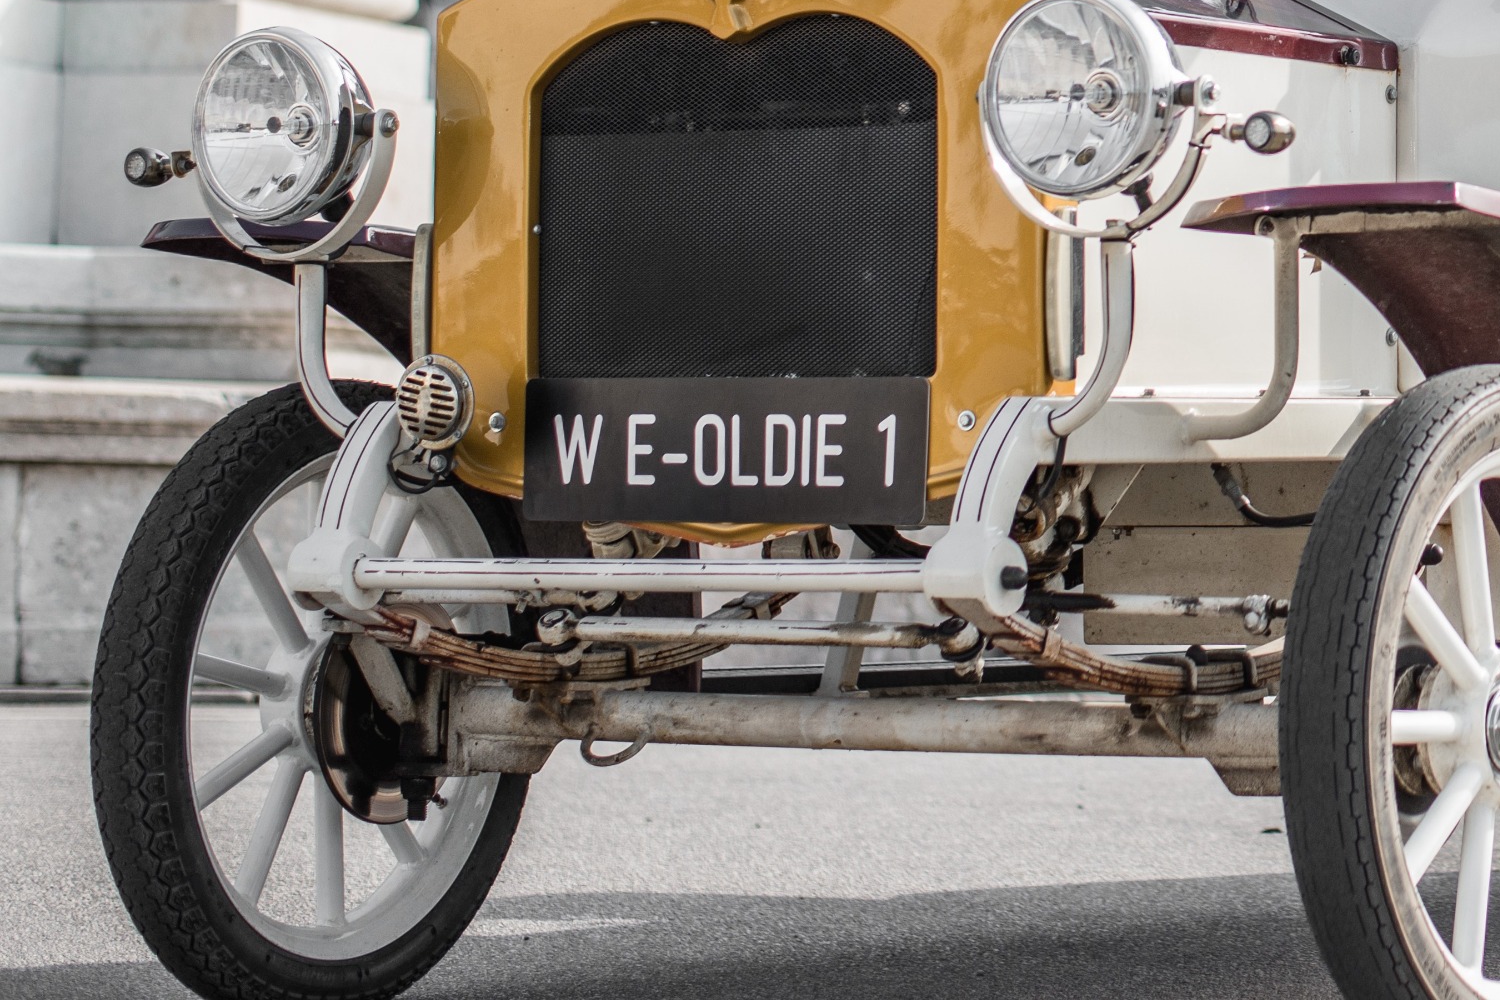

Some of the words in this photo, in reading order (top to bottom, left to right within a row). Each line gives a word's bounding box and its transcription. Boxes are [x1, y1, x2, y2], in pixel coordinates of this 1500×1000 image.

[553, 413, 604, 486] W
[626, 413, 847, 488] E-OLDIE
[877, 413, 897, 488] 1
